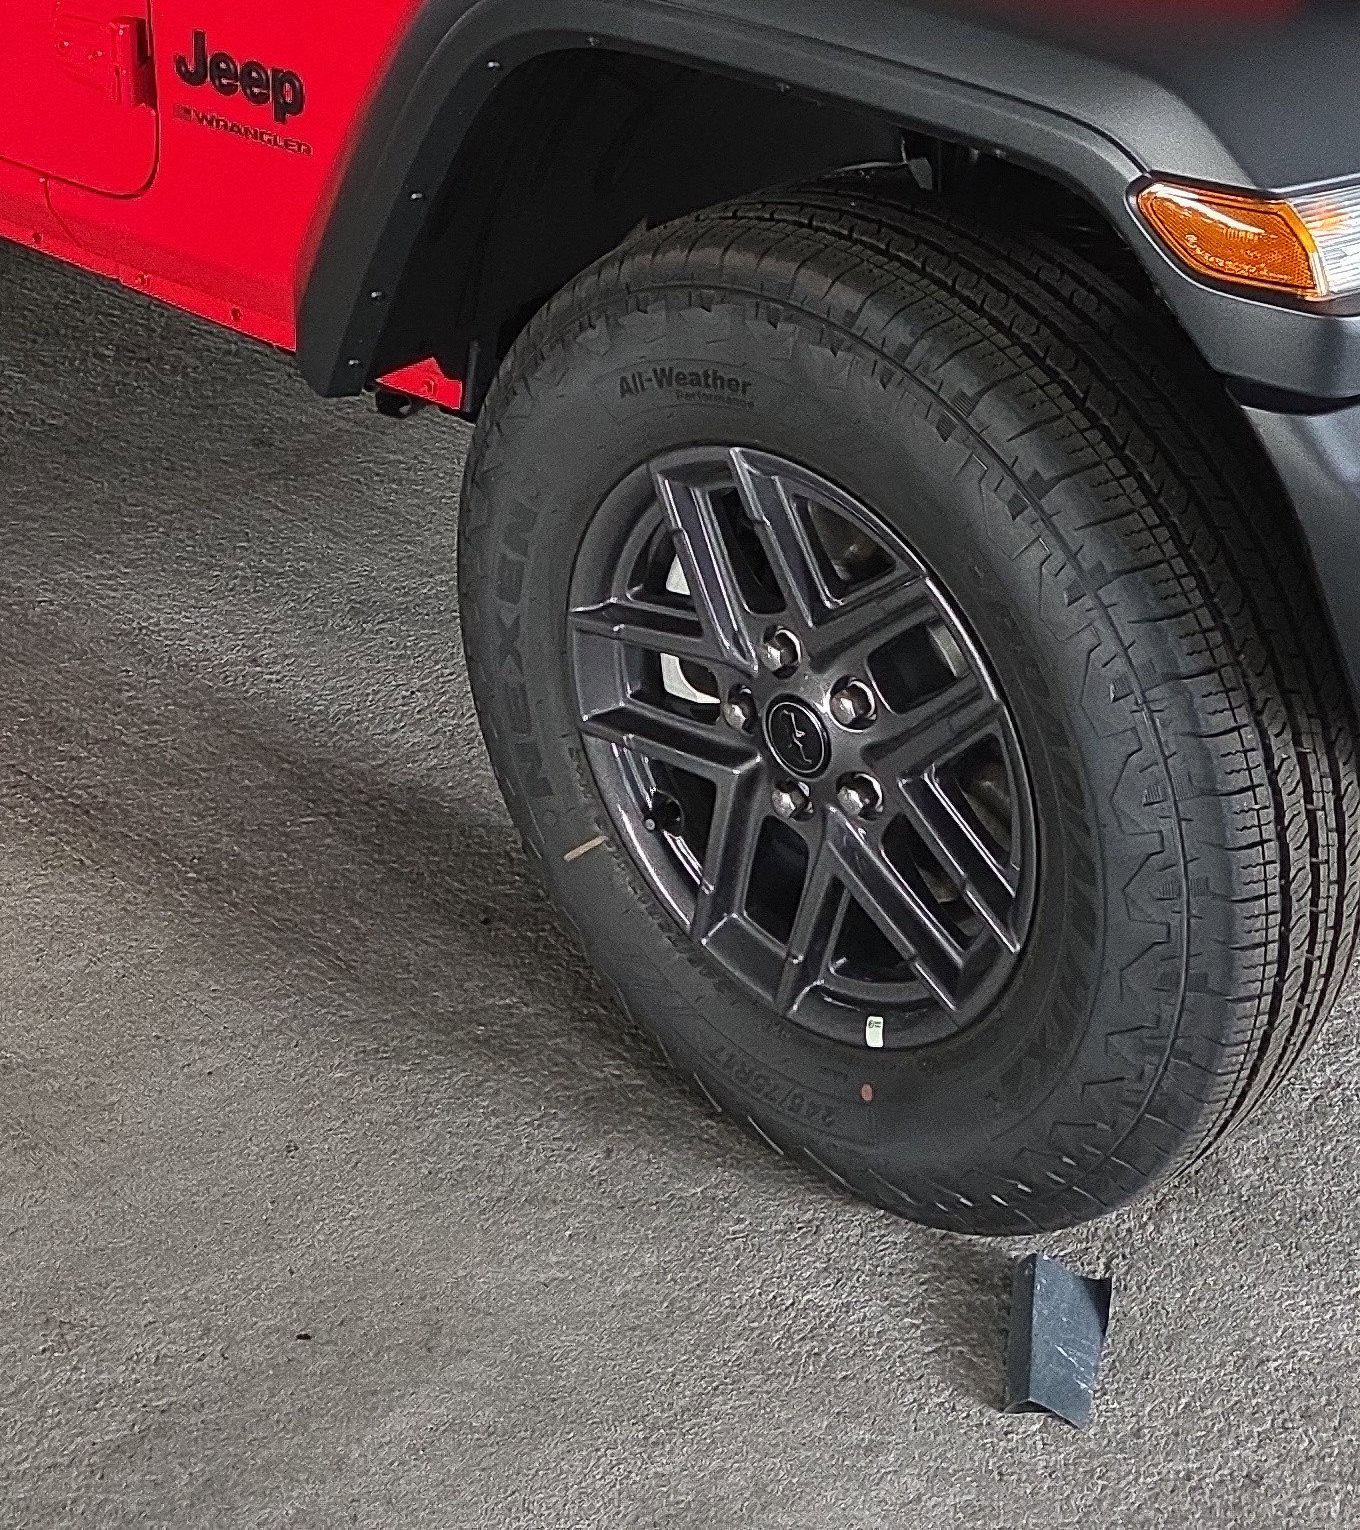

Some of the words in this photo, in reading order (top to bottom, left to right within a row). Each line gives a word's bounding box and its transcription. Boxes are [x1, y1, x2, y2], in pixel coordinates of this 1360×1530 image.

[174, 29, 306, 124] Jeep
[192, 108, 313, 156] WRANGLER
[619, 366, 752, 398] All-Weather
[676, 390, 754, 409] Performance
[496, 500, 555, 798] NEXEN
[707, 1045, 836, 1126] 245/75R17
